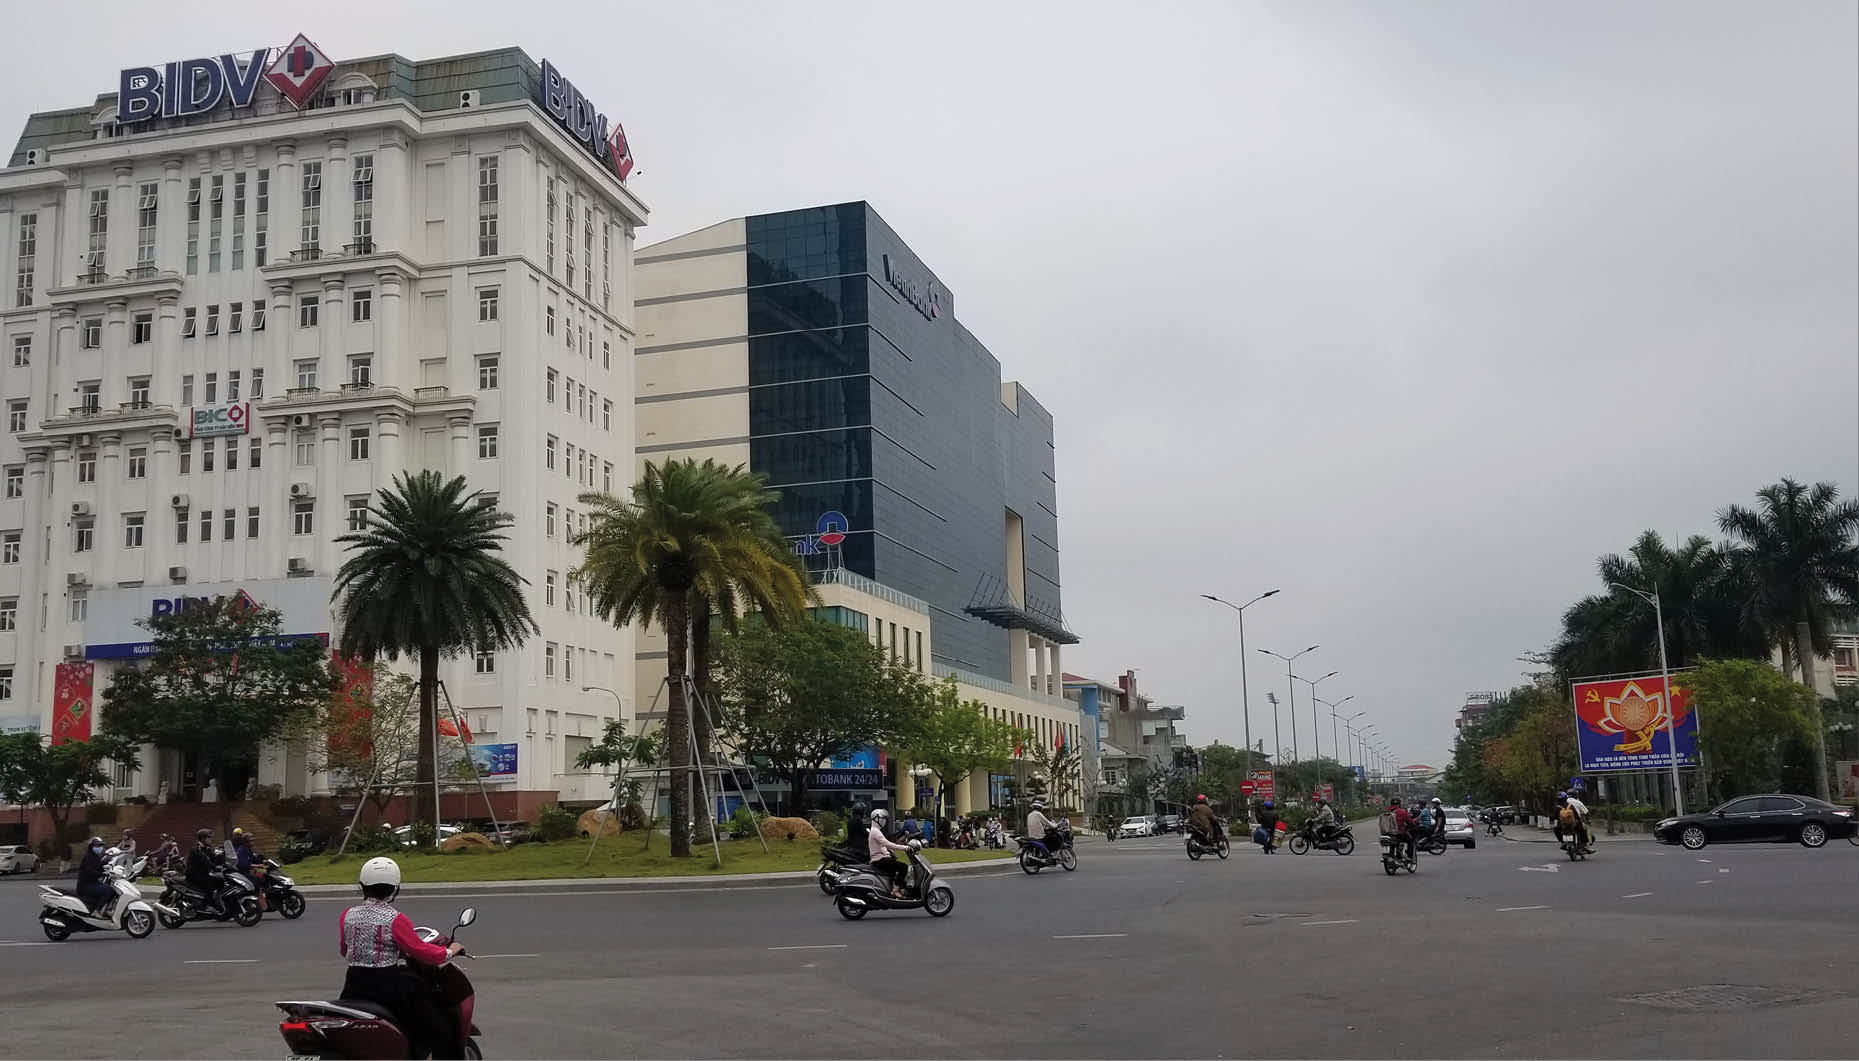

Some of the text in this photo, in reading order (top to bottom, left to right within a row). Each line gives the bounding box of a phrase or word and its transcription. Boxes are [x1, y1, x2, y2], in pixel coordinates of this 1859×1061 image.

[118, 48, 271, 124] BIDV
[541, 58, 608, 157] BIDV
[195, 408, 228, 424] BIC
[802, 774, 852, 785] ATOBANK
[855, 774, 878, 785] 24/24
